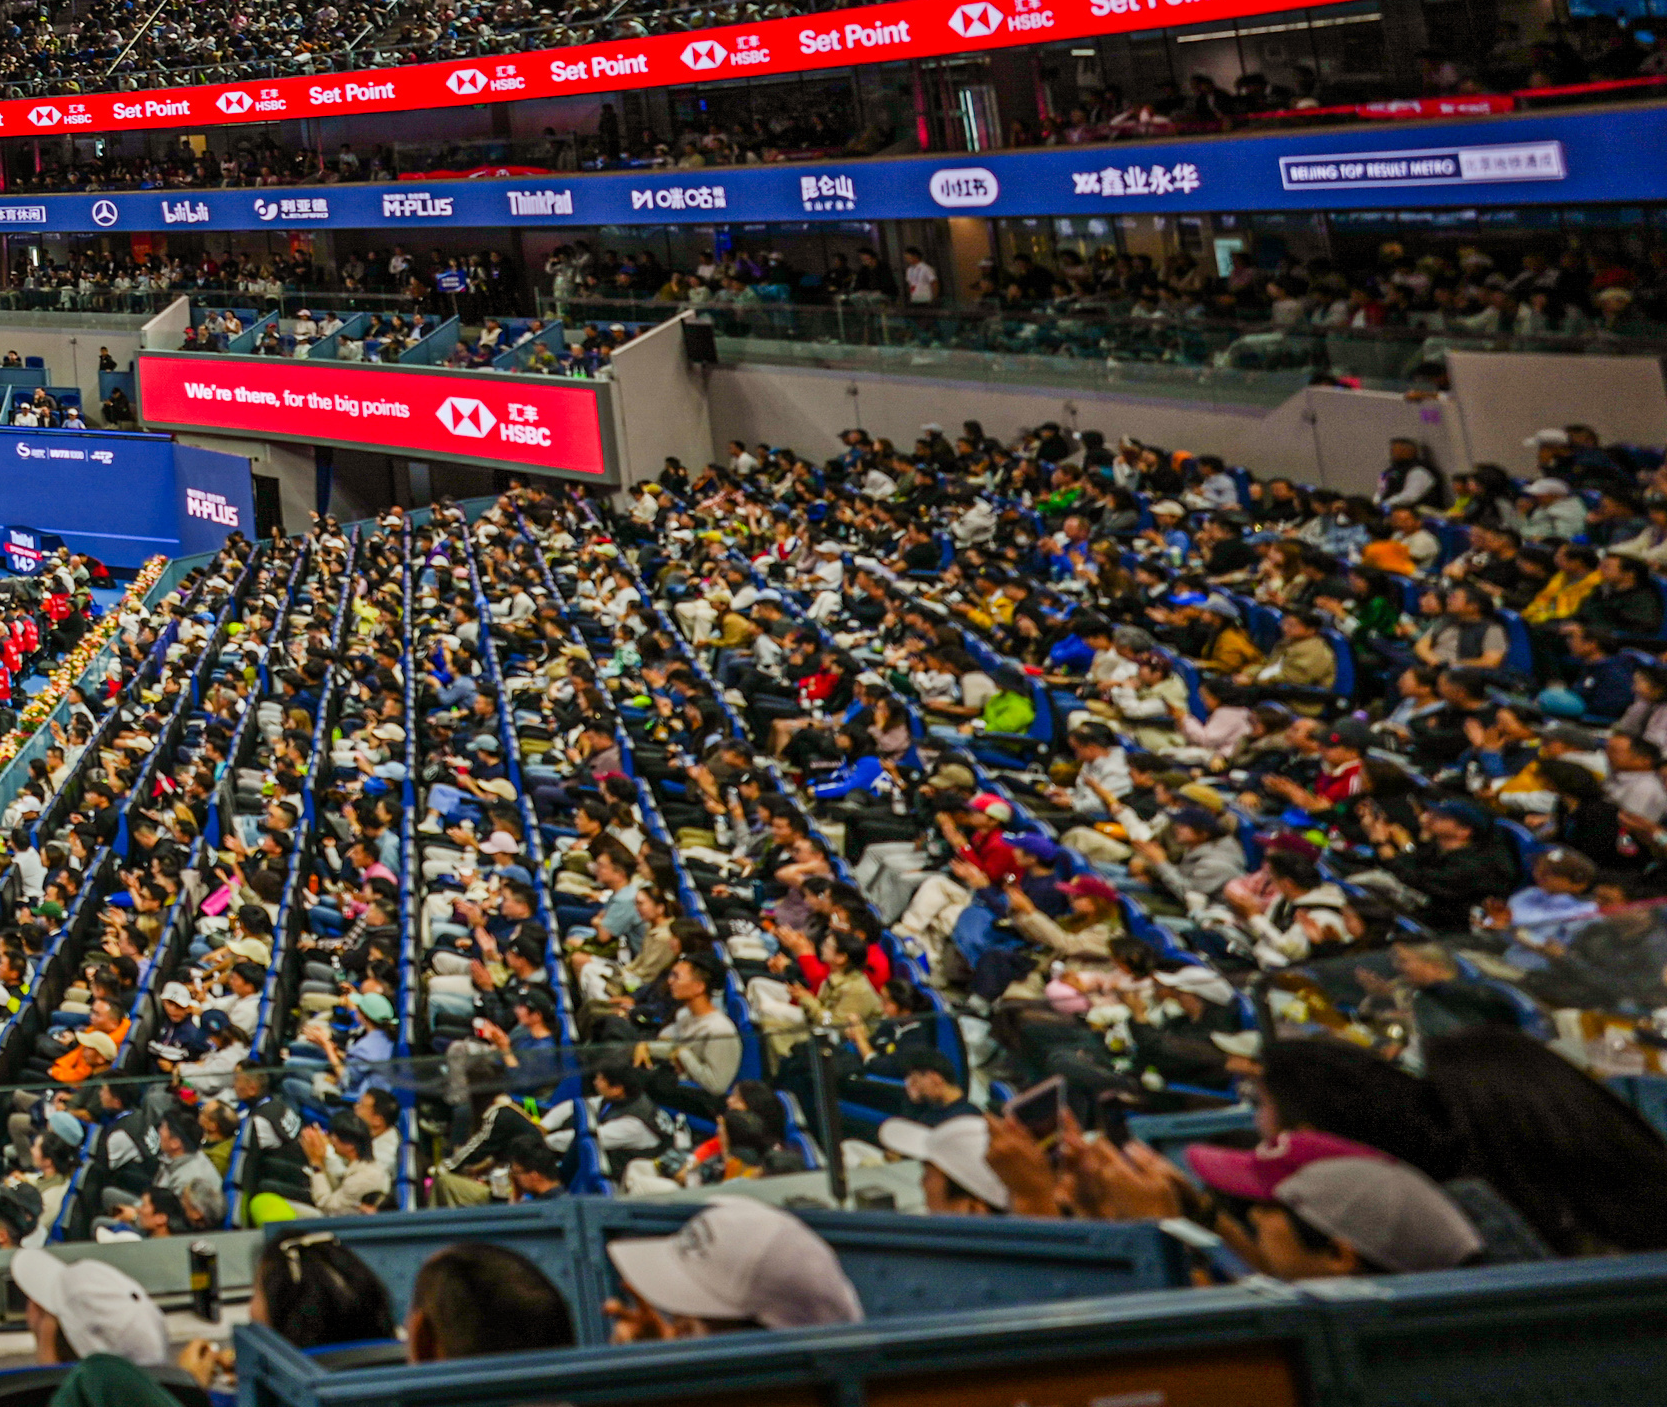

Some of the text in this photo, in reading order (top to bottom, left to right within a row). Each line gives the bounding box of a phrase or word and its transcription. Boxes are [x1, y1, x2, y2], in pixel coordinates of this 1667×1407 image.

[799, 20, 911, 54] Set Point
[550, 54, 648, 82] Set Point
[309, 82, 395, 104] Set Point
[113, 100, 190, 119] Set Point
[1100, 163, 1201, 194] 鑫业永华
[1290, 165, 1338, 182] BEIJING
[1340, 164, 1365, 180] TOP
[1366, 162, 1409, 179] RESULT
[1410, 159, 1456, 178] METRO
[800, 174, 855, 201] 昆仑山
[940, 178, 989, 196] 小红书
[162, 201, 209, 223] bilibili
[280, 197, 329, 214] 利亚德
[507, 190, 573, 215] ThinkPad
[184, 382, 410, 418] We're there, for the big points
[508, 403, 539, 423] 汇丰
[500, 423, 551, 446] HSBC
